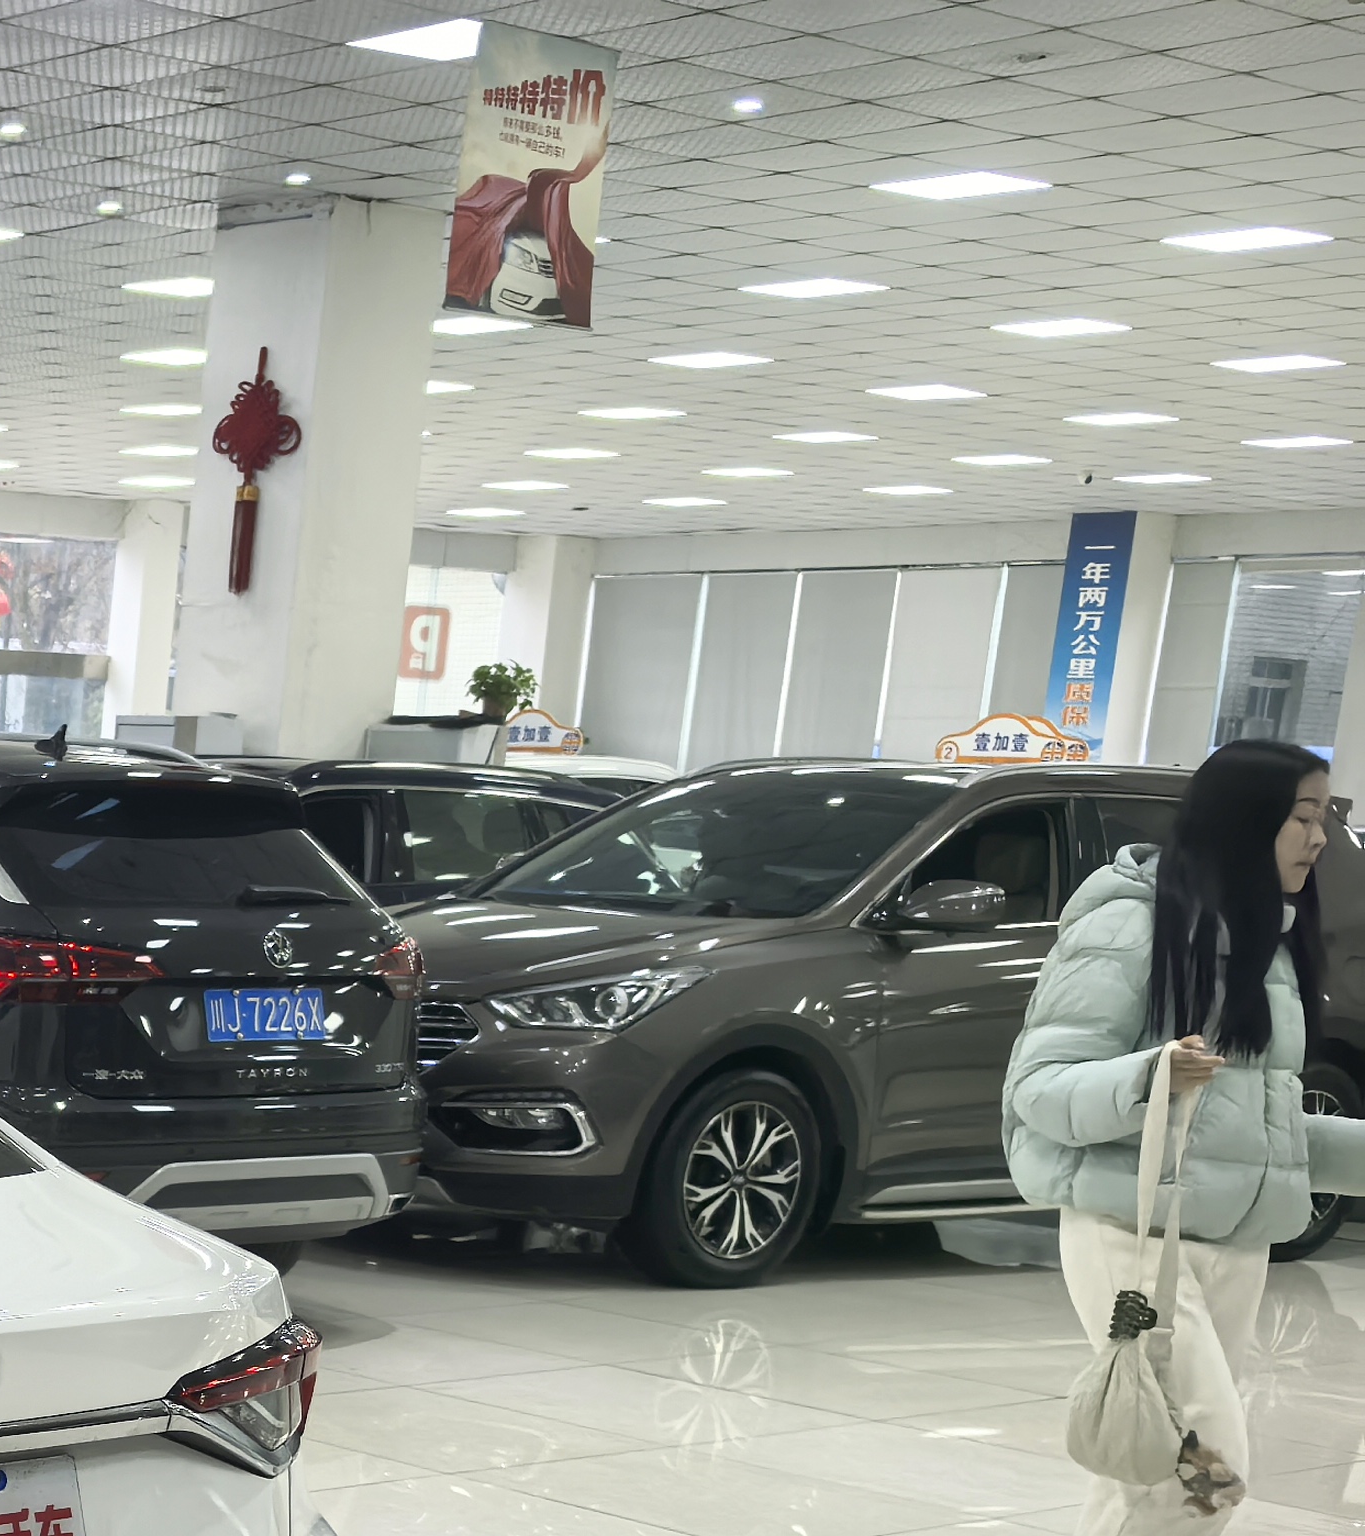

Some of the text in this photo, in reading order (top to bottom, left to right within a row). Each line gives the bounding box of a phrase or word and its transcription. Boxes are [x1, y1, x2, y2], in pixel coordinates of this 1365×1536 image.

[1062, 545, 1116, 726] 一年两万公里质保
[973, 732, 1029, 752] 壹加壹
[236, 1067, 308, 1079] TAYRON
